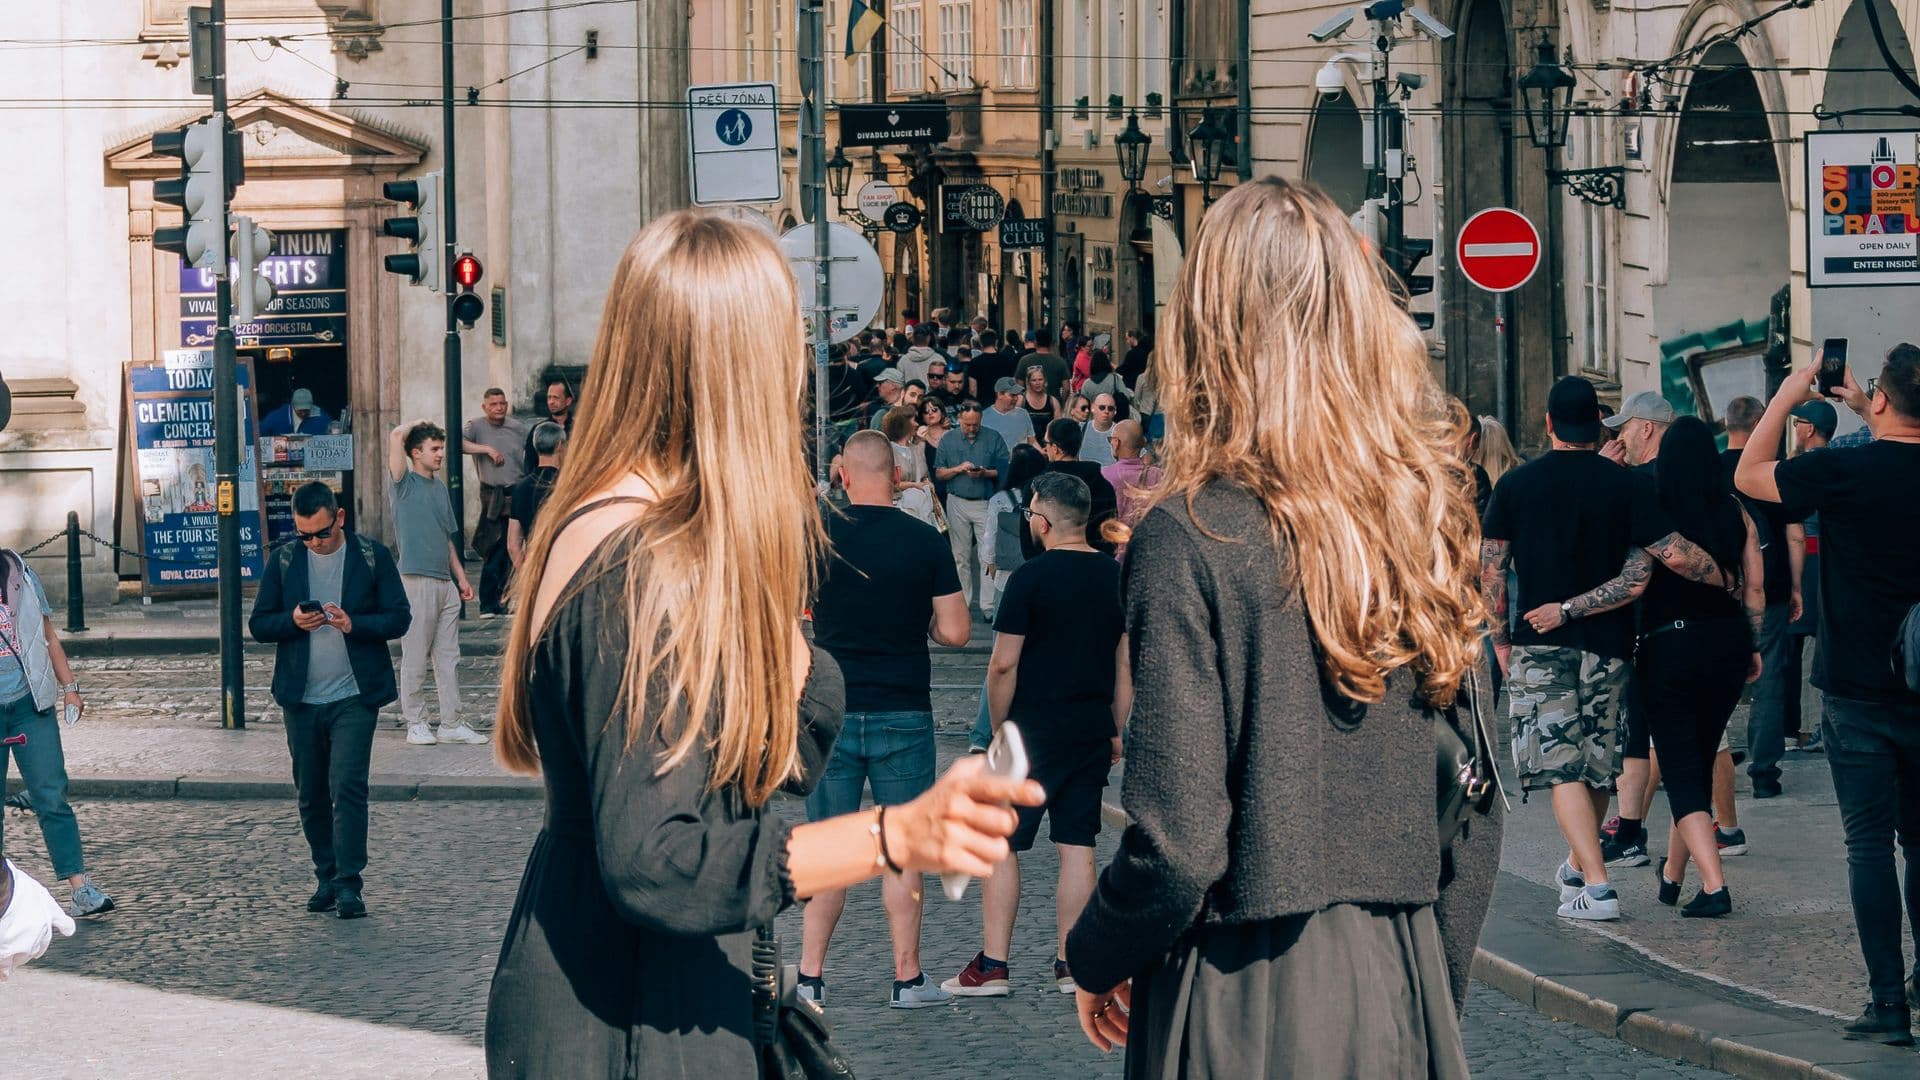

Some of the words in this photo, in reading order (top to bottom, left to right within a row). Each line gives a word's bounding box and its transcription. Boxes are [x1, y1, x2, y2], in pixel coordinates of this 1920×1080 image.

[732, 91, 766, 104] ZÓNA
[857, 131, 889, 139] DIVADLO
[891, 129, 913, 137] LUCIE
[1823, 166, 1919, 190] STOR
[971, 195, 995, 207] GOOD
[971, 207, 995, 219] FOOD
[1003, 221, 1043, 232] MUSIC
[1002, 231, 1045, 244] CLUB
[1886, 242, 1911, 250] DAILY
[1853, 261, 1885, 269] ENTER
[1886, 260, 1918, 268] INSIDE
[286, 296, 330, 310] SEASONS
[235, 323, 263, 335] CZECH
[264, 321, 312, 333] ORCHESTRA
[167, 368, 214, 390] TODAY
[311, 448, 348, 458] TODAY
[154, 532, 174, 545] THE
[176, 530, 203, 543] FOUR
[160, 569, 182, 581] ROYAL
[184, 568, 208, 580] CZECH
